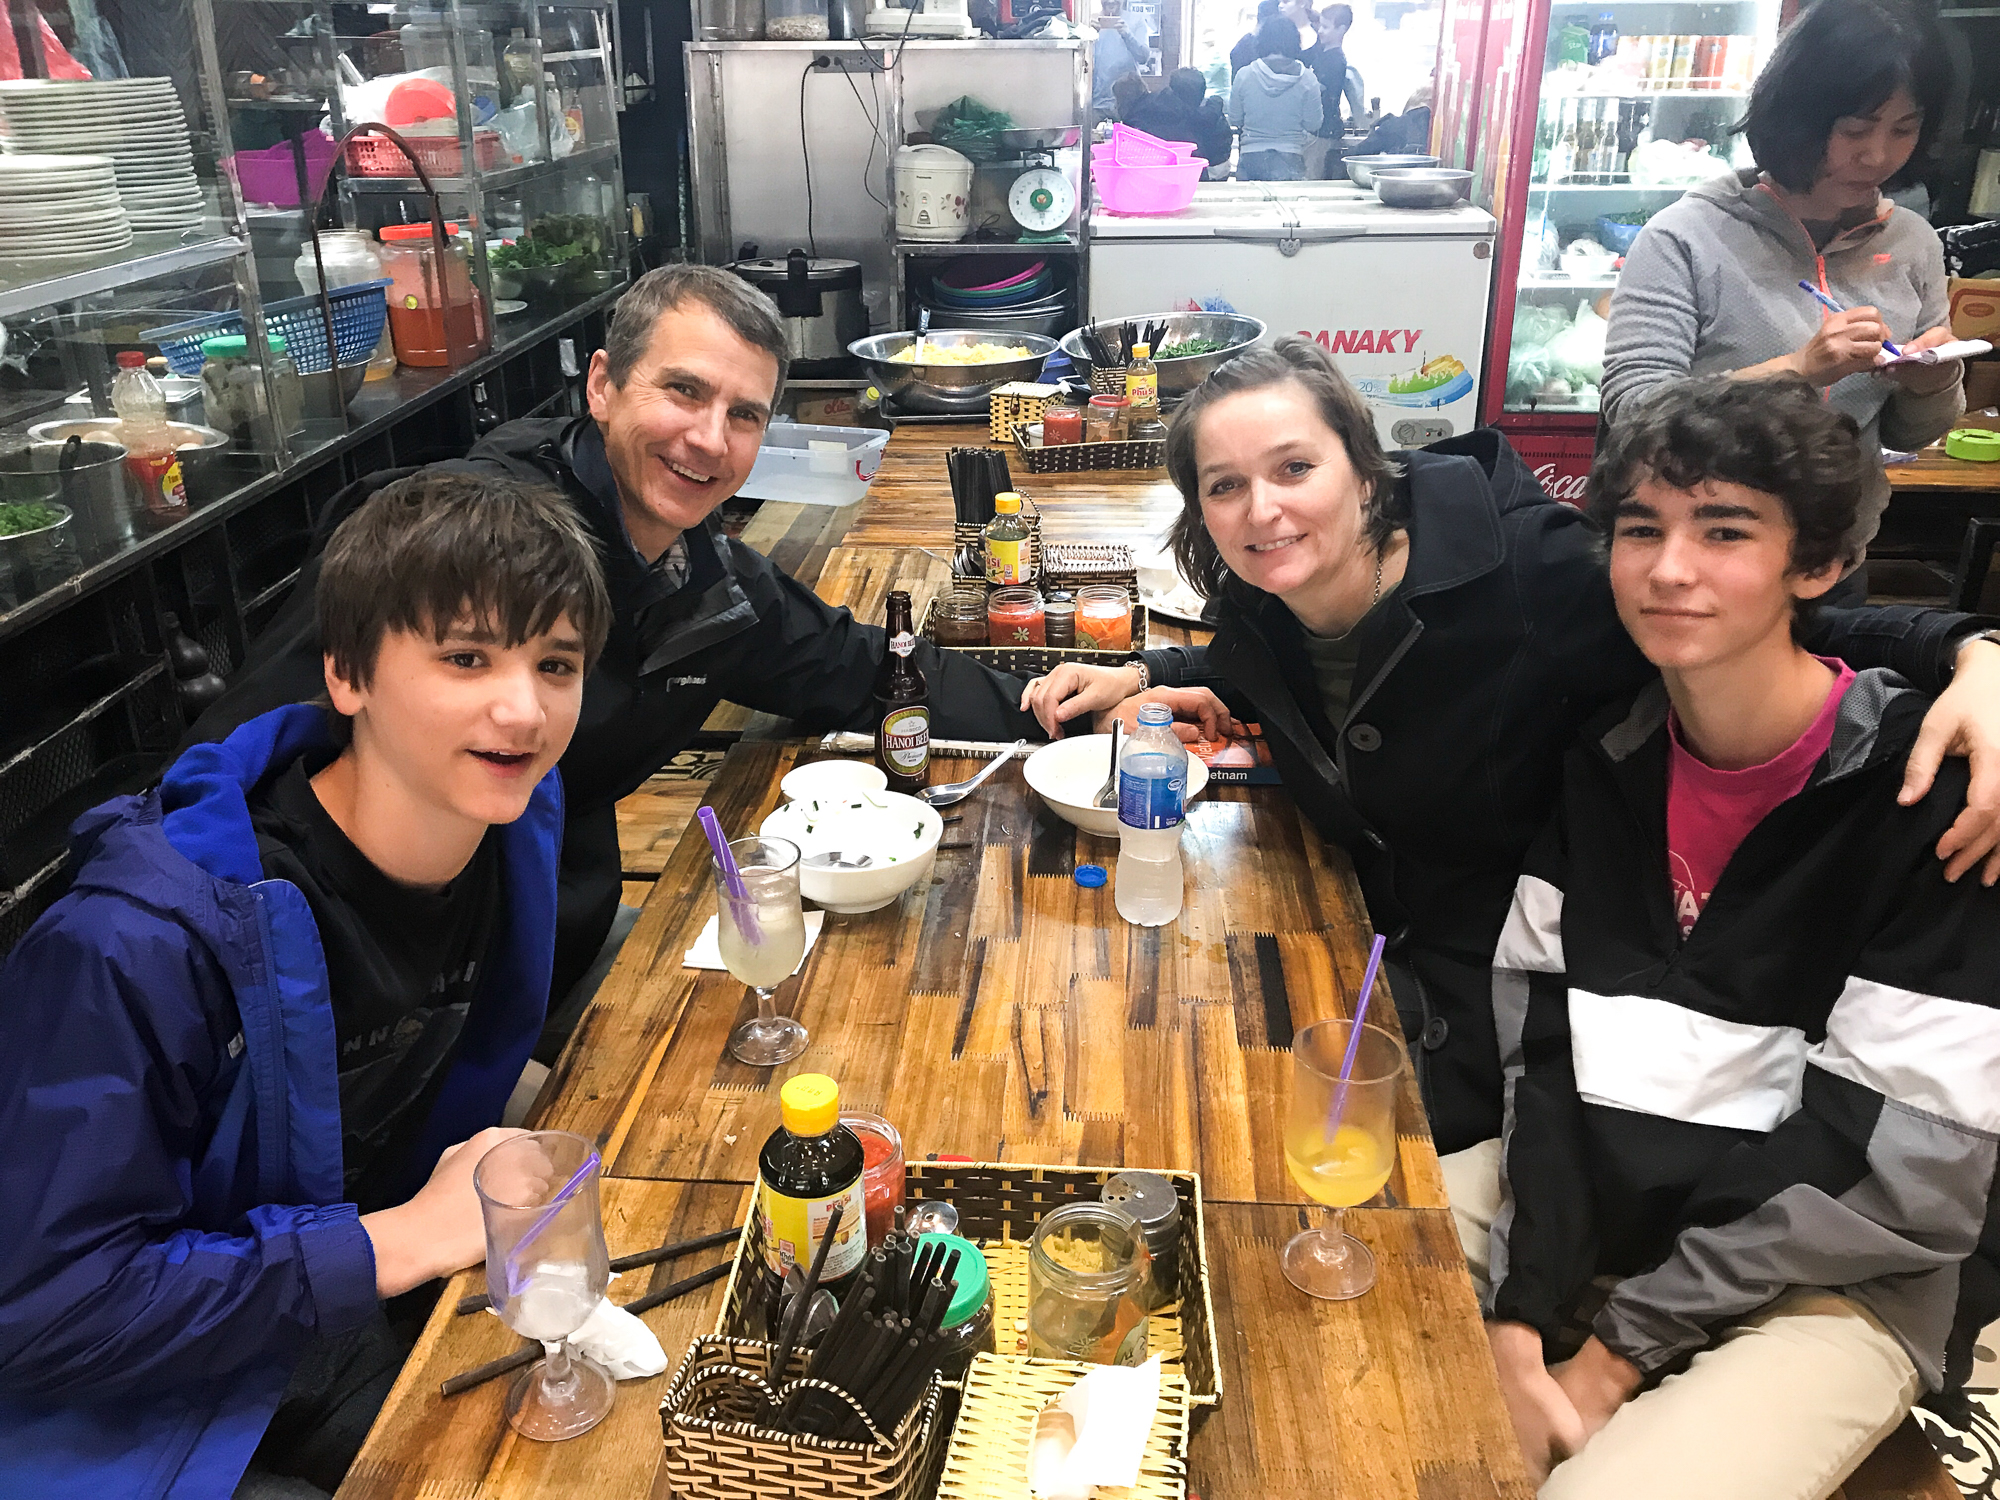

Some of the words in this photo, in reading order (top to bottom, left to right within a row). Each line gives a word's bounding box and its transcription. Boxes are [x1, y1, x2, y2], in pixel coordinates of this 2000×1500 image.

[1297, 329, 1423, 354] ANAKY
[885, 733, 915, 749] HANOI
[1209, 770, 1248, 780] etnam
